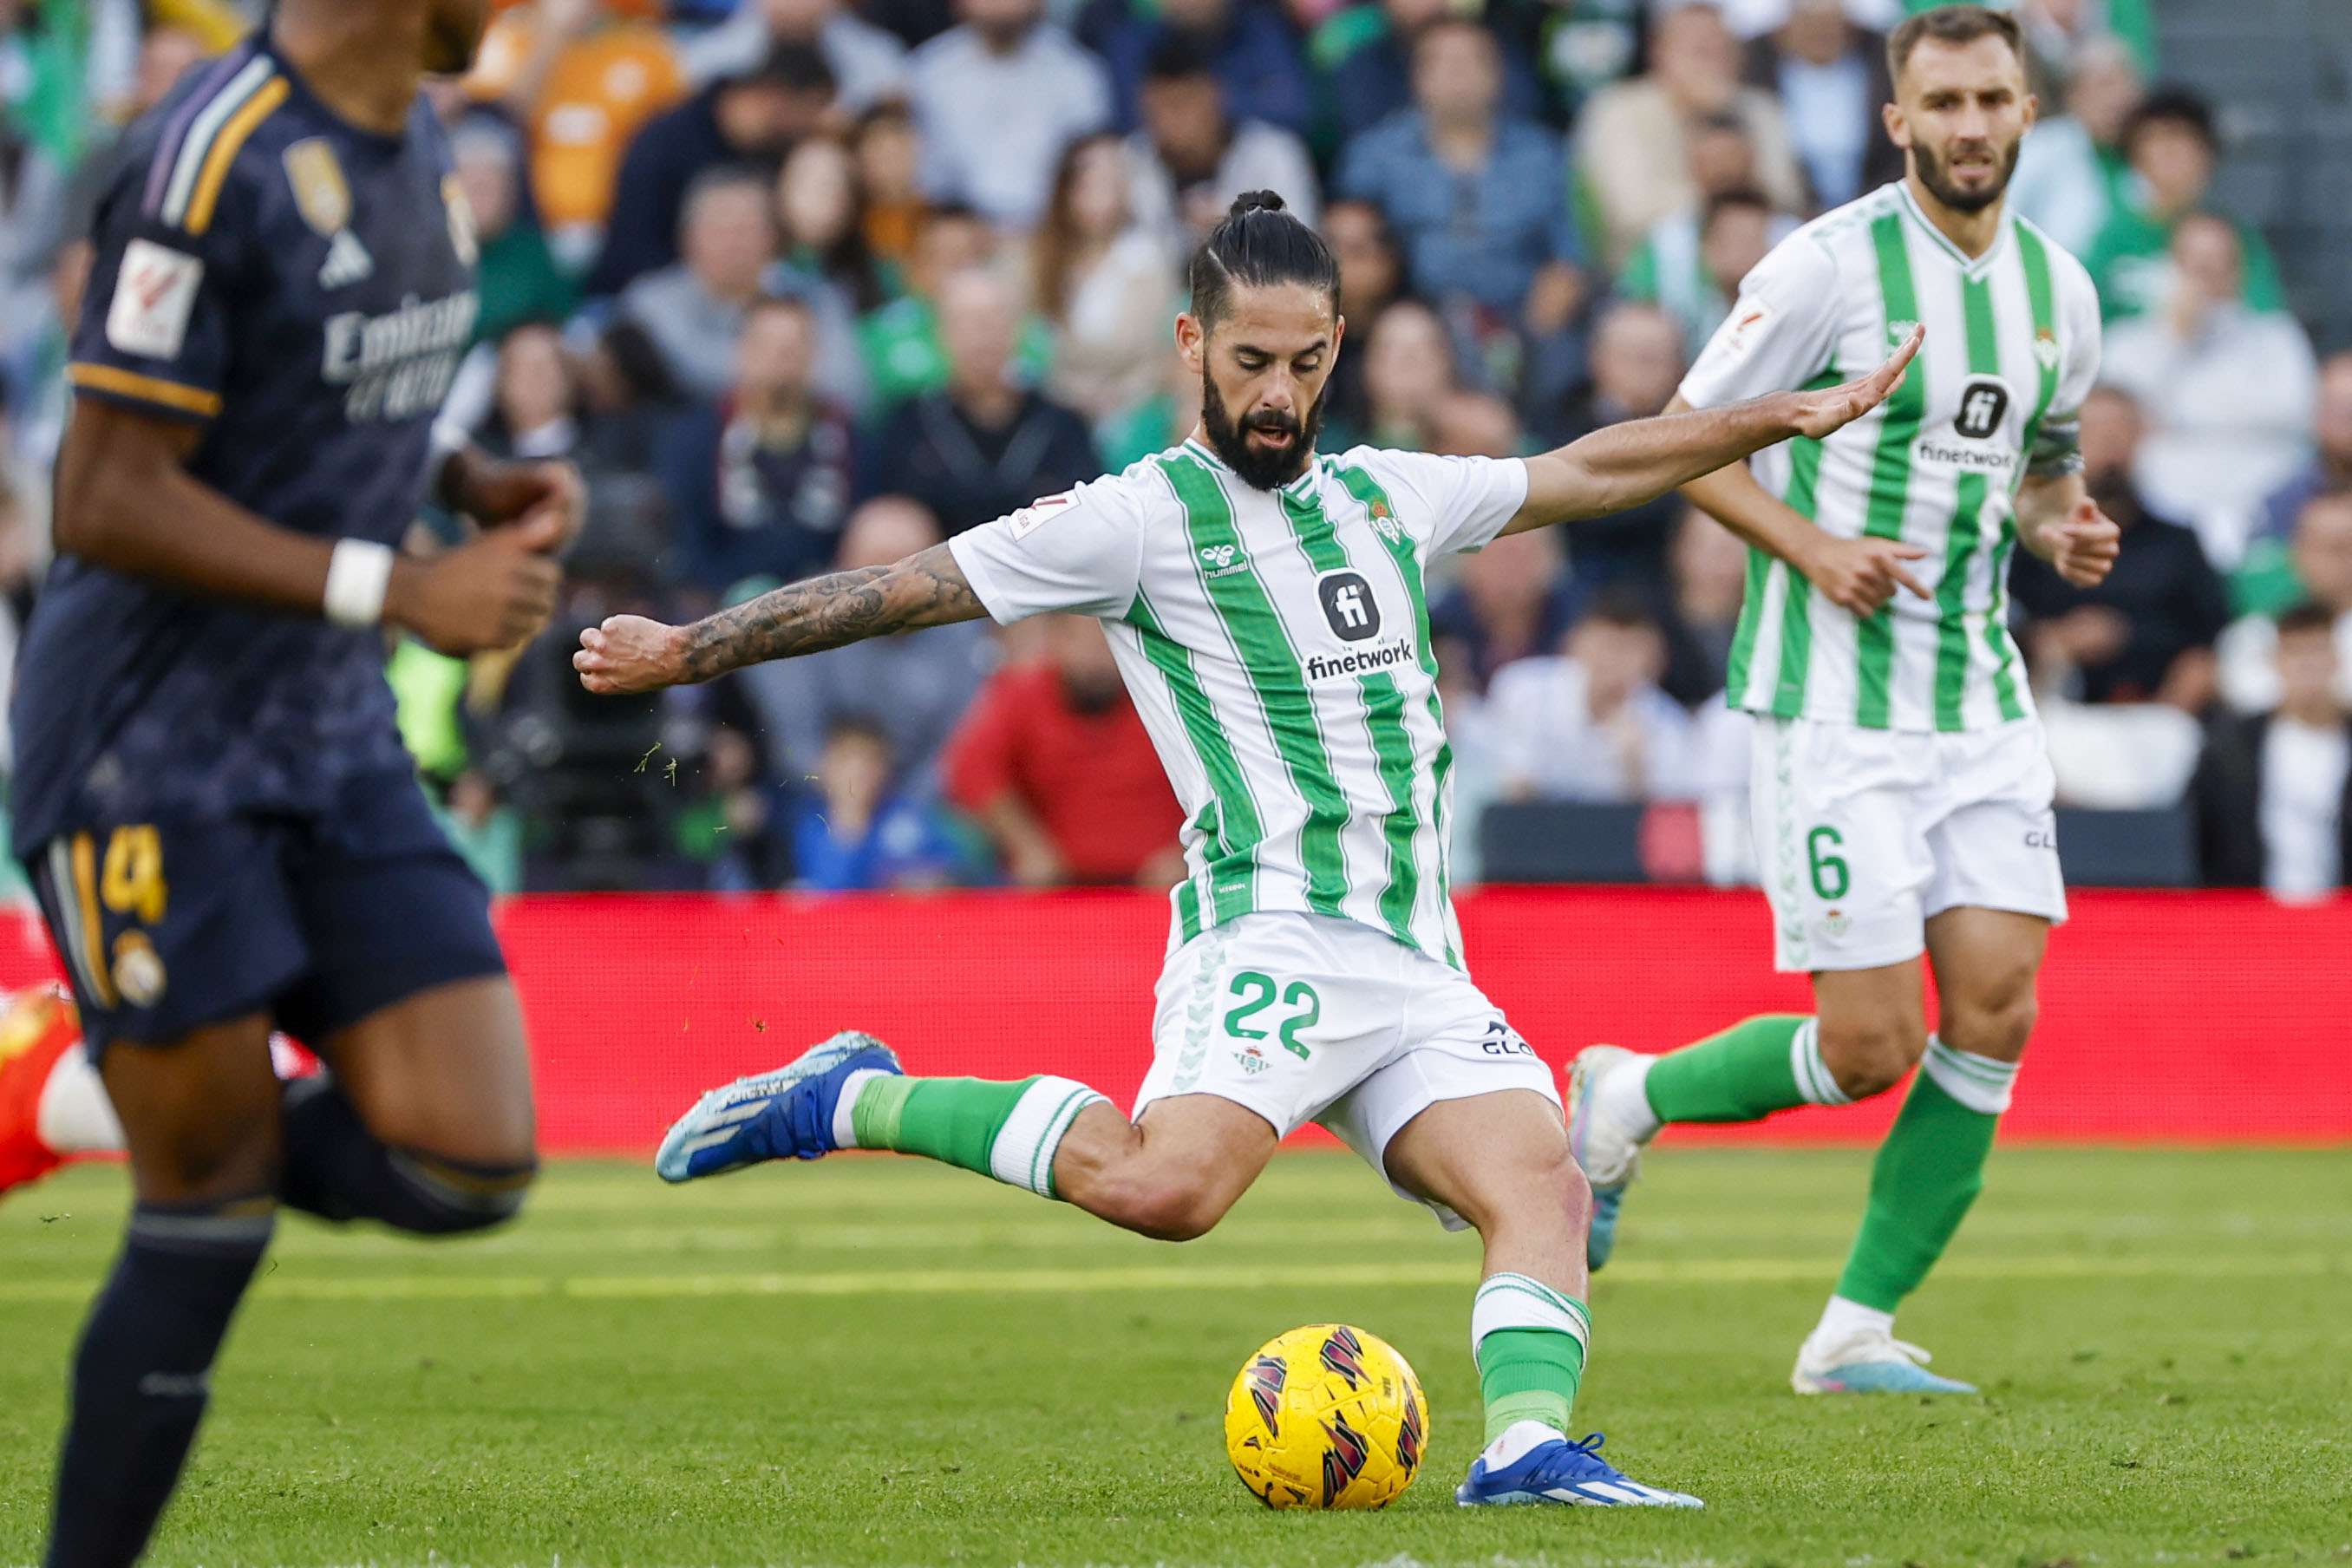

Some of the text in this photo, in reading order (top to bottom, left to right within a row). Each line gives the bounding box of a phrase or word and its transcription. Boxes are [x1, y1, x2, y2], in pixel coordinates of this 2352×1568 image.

[1204, 559, 1249, 580] hummel
[1307, 638, 1414, 680] finetwork
[101, 824, 165, 924] 4
[1808, 826, 1848, 899] 6
[1224, 971, 1320, 1061] 22
